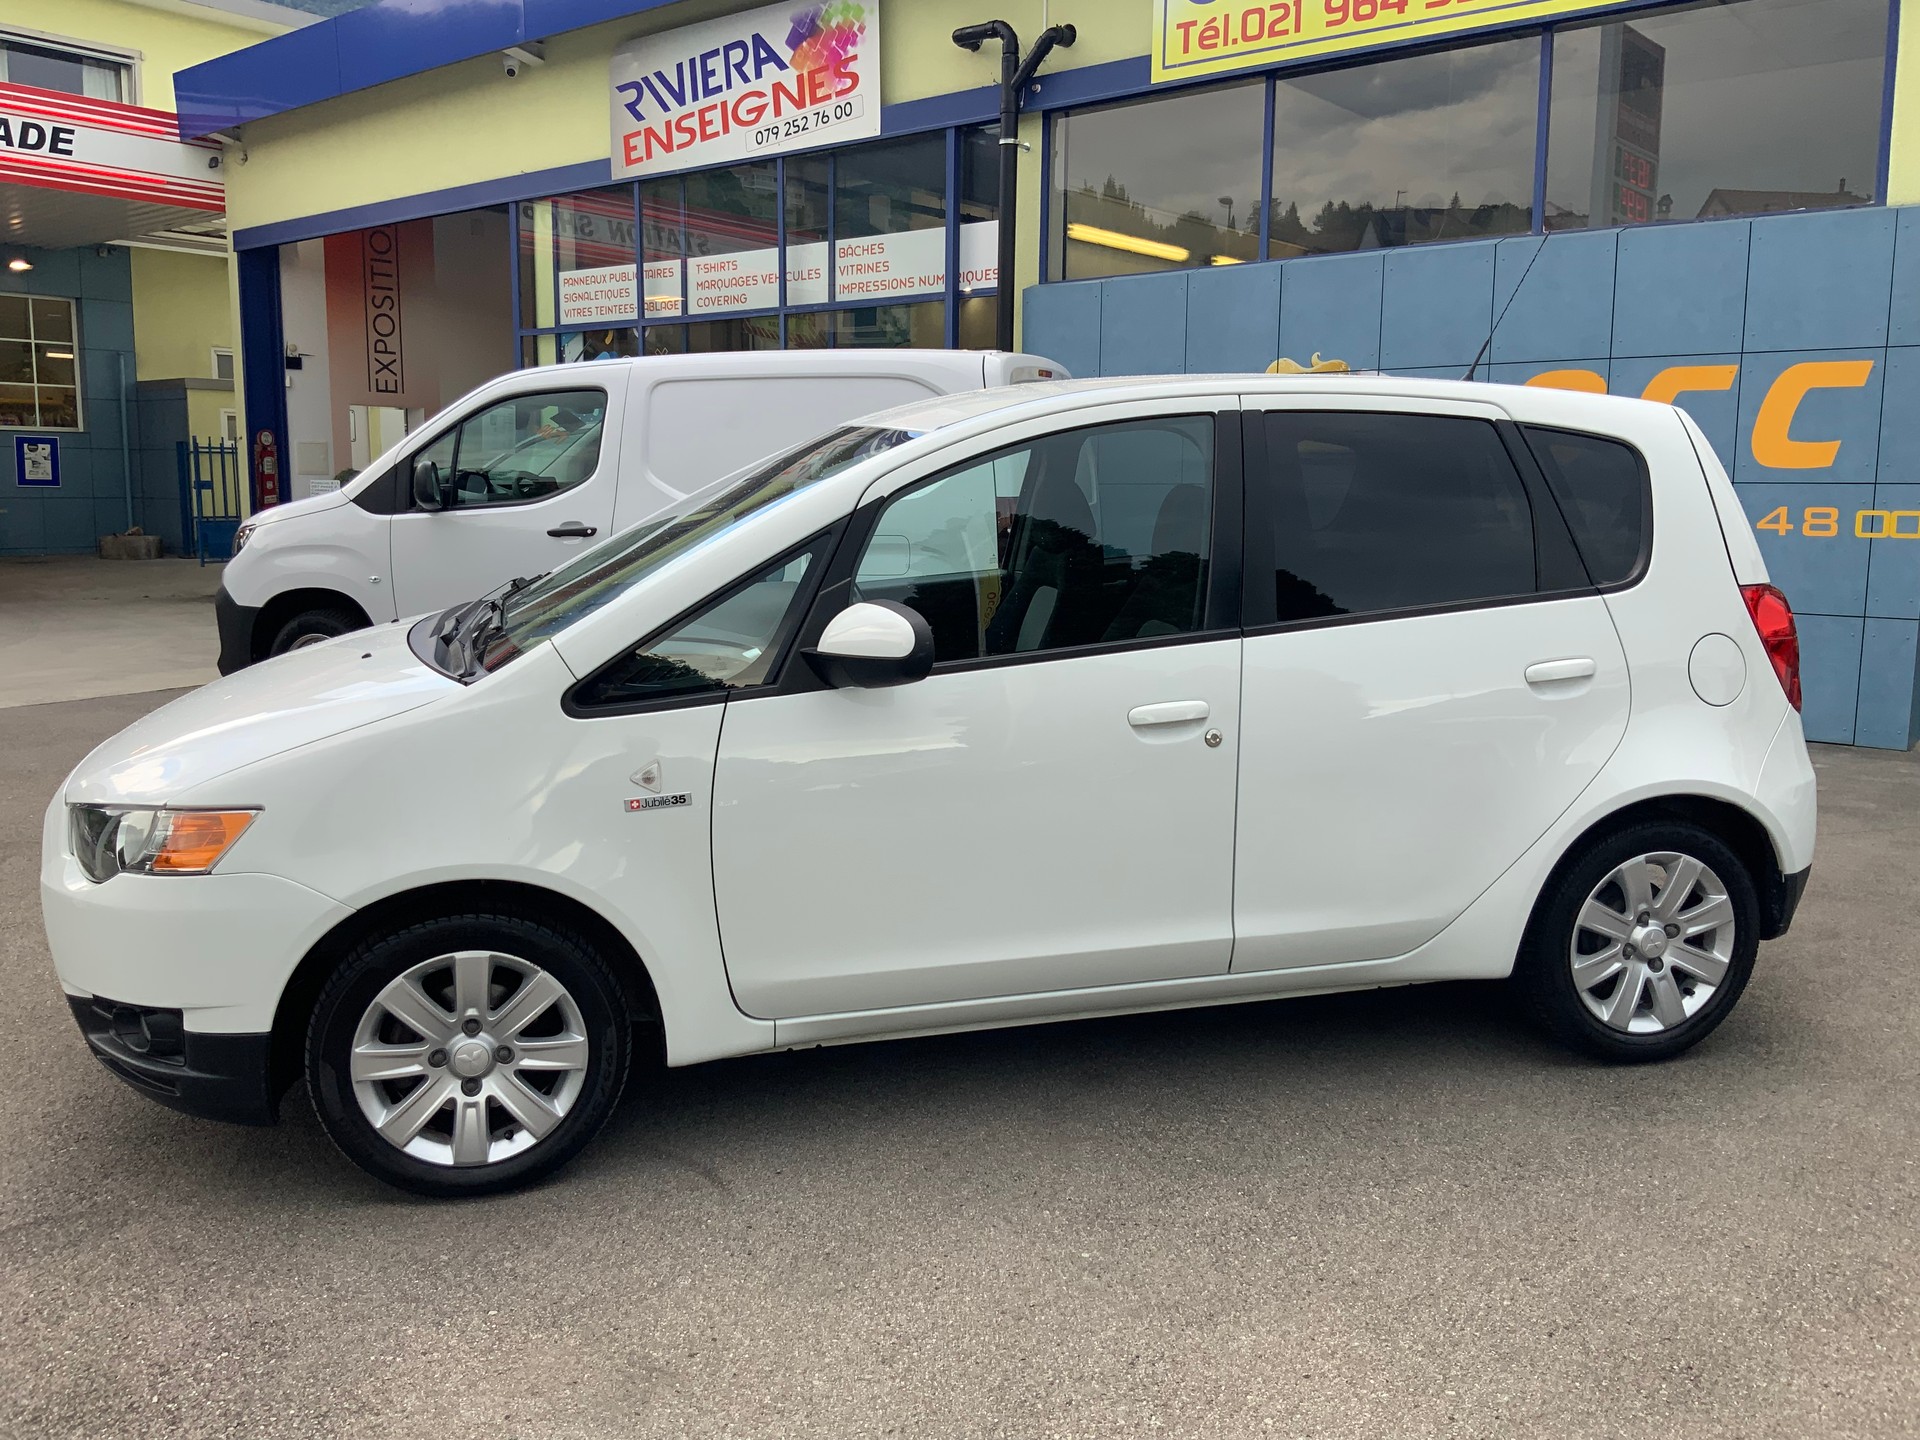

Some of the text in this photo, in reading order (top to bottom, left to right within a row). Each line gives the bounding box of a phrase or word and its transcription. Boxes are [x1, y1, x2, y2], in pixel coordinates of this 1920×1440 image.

[1176, 0, 1302, 54] Tél.021
[615, 33, 789, 122] RIVIERA
[623, 54, 860, 167] ENSEIGNES
[755, 101, 853, 146] 079 252 76 00
[0, 117, 75, 156] ADE
[839, 243, 885, 258] BÂCHES
[563, 267, 674, 287] PANNEAUX PUBLITAIRES
[696, 260, 738, 274] T-SHIRTS
[839, 261, 889, 276] VITRINES
[696, 268, 821, 291] MARQUAGES VEHCULES
[839, 268, 999, 294] IMPRESSIONS NUMRIQUES
[563, 288, 630, 303] SIGNALETIQUES
[696, 293, 747, 308] COVERING
[369, 225, 398, 393] EXPOSITIO
[564, 307, 593, 318] VITRES
